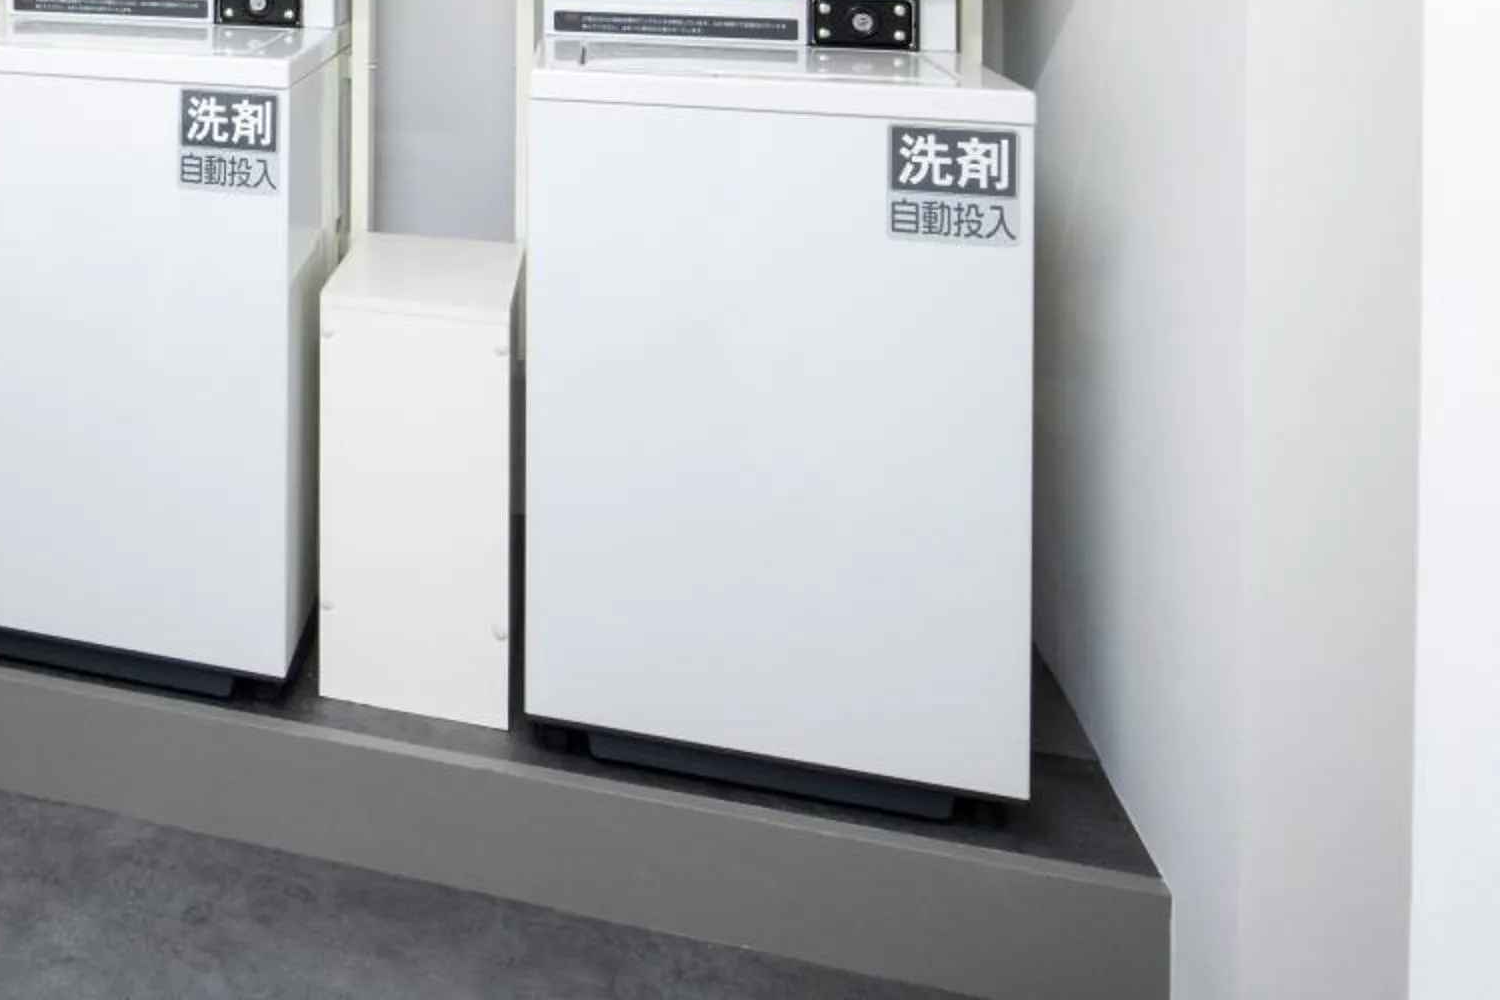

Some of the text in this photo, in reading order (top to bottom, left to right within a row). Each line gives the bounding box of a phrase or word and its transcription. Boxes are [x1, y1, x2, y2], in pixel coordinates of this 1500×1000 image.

[187, 96, 272, 146] 洗剤
[180, 152, 277, 190] 自動投入
[898, 133, 1010, 190] 洗剤
[891, 197, 1016, 241] 自動投入
